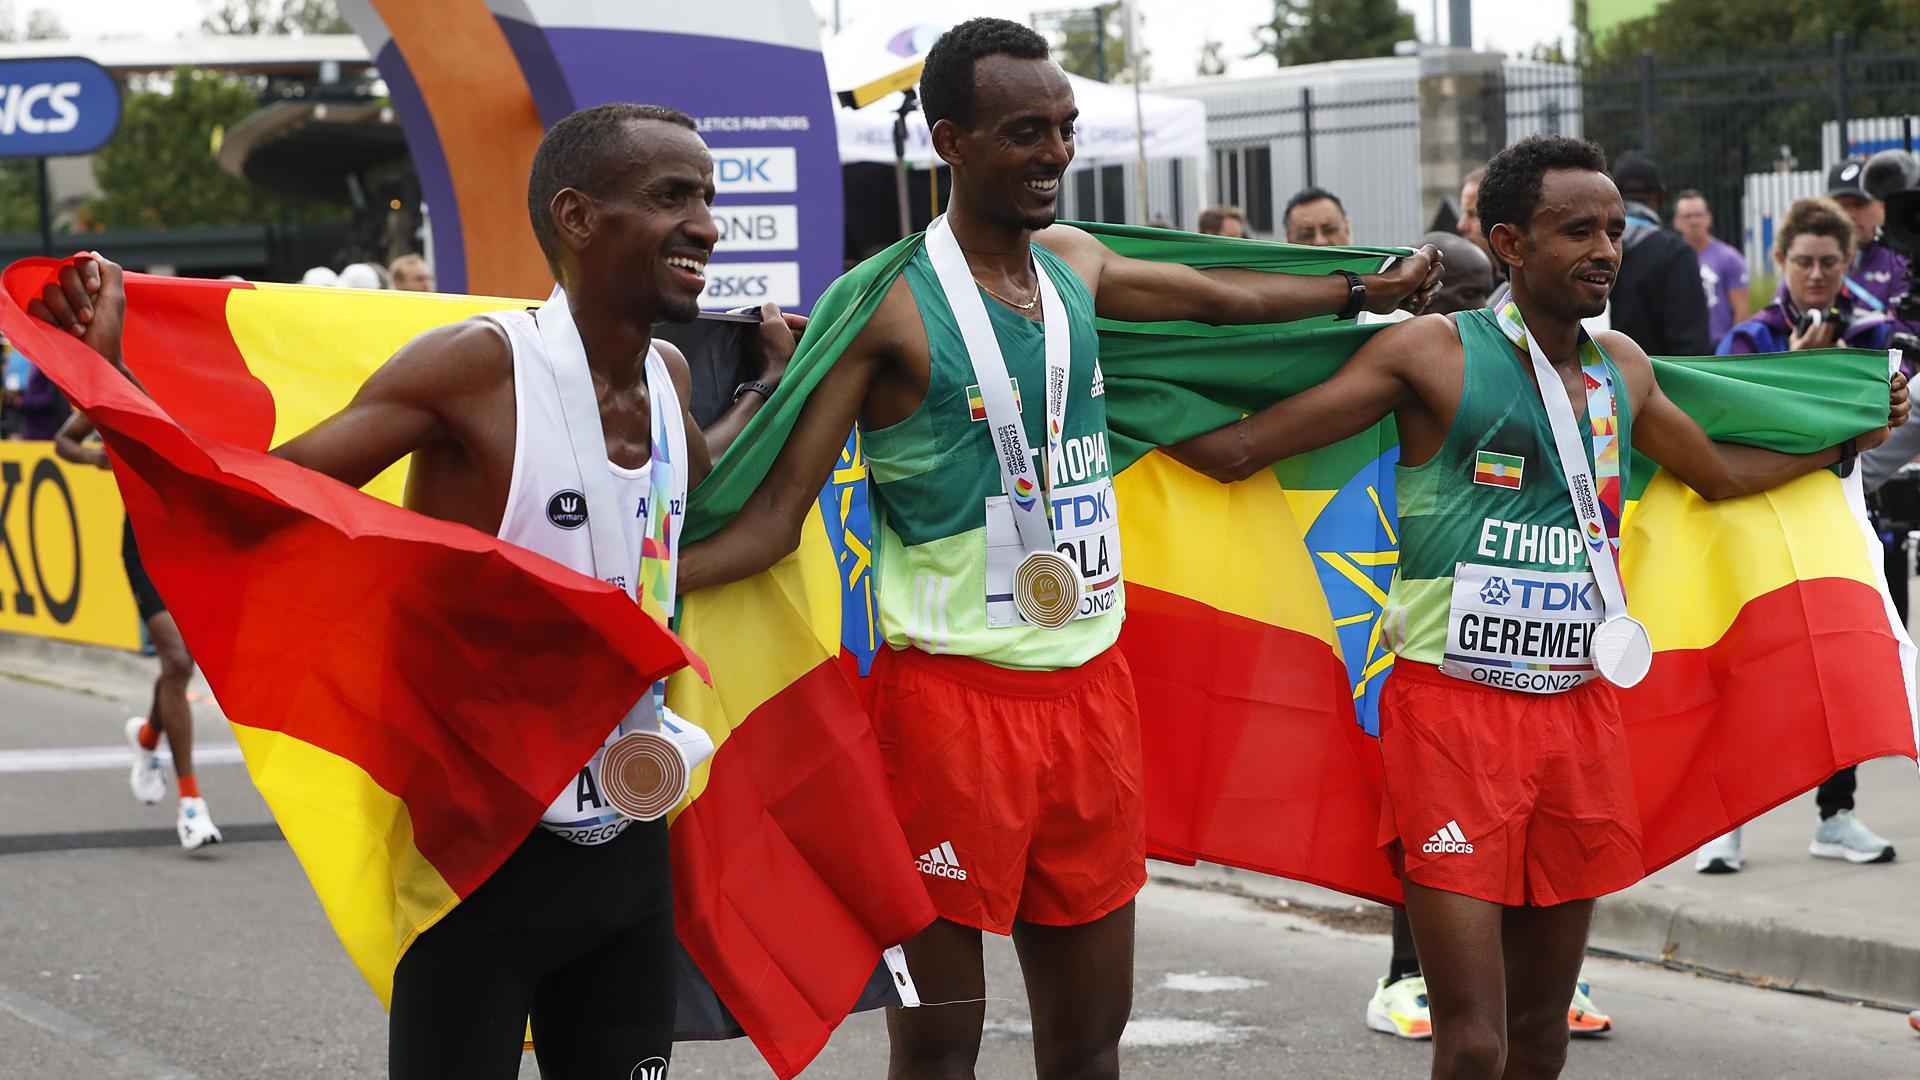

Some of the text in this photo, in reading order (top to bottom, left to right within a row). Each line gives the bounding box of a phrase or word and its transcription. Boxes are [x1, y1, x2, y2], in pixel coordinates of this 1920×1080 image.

[0, 82, 81, 134] ICS
[697, 115, 809, 132] LETICS PARTNERS
[714, 158, 770, 182] DK
[712, 213, 777, 242] QNB
[707, 275, 768, 298] asics
[997, 426, 1015, 477] WORLD ATHLETICS
[1002, 425, 1020, 475] CHAMPIONSHIPS
[553, 513, 584, 521] vermarc
[1051, 489, 1110, 531] TDK
[1056, 534, 1110, 579] OLA
[1477, 517, 1590, 567] ETHIOP
[1511, 578, 1593, 611] TDK
[1471, 667, 1582, 691] OREGON22
[1422, 839, 1474, 854] adidas
[914, 859, 967, 881] adidas
